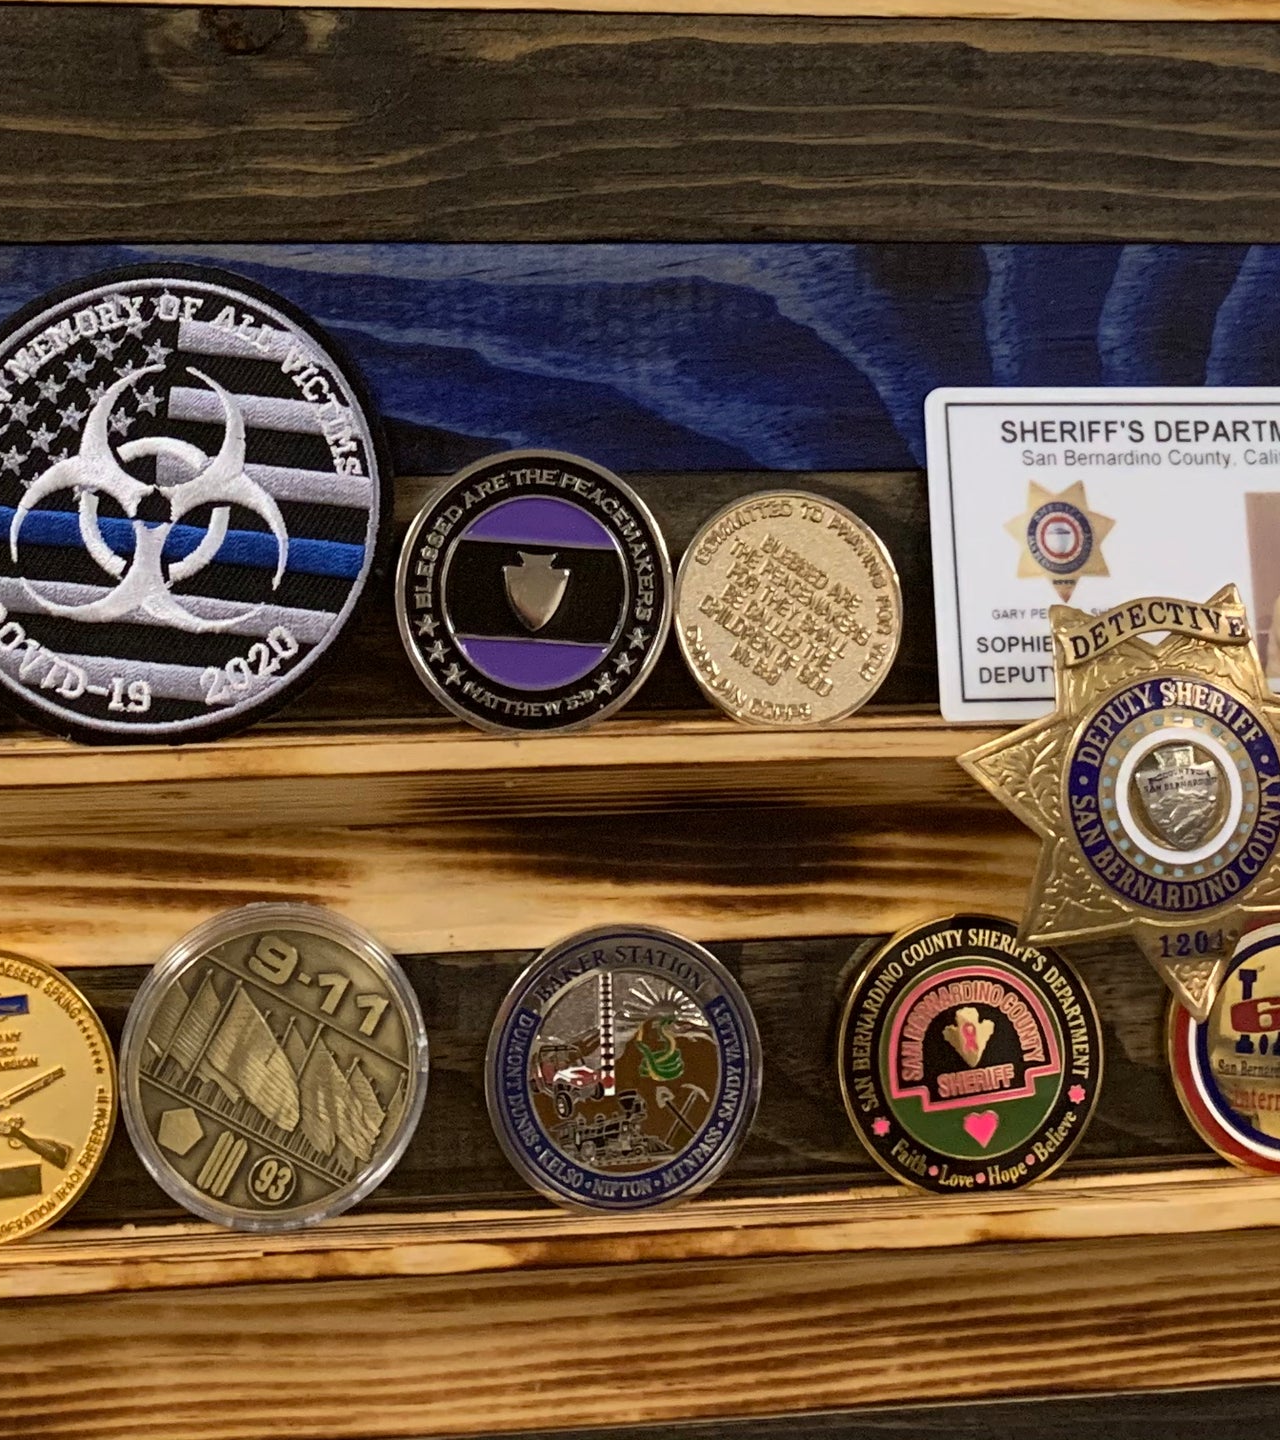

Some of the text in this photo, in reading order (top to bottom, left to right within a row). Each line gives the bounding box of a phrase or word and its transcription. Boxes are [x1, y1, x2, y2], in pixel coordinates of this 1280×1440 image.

[5, 294, 146, 385] MEMORY
[157, 291, 205, 323] OF
[210, 305, 279, 351] ALL
[280, 348, 363, 477] VICTIMS
[1000, 419, 1145, 444] SHERIFF'S
[1022, 449, 1058, 467] San
[1063, 448, 1162, 467] Bernardino
[1168, 448, 1237, 470] County,
[414, 504, 464, 609] BLESSED
[461, 472, 510, 510] ARE
[511, 468, 560, 485] THE
[560, 472, 657, 623] PEACEMAKERS
[199, 624, 300, 706] 2020
[1069, 600, 1249, 661] DETECTIVE
[1081, 679, 1268, 768] DEPUTY SHERIFF
[1070, 794, 1097, 841] SAN
[1092, 843, 1241, 910] BERNARDINO
[533, 945, 705, 1003] BAKER STATION
[936, 1063, 1016, 1100] SHERIFF
[253, 1158, 293, 1201] 93
[890, 1110, 1079, 1189] Faith Love Hope Believe
